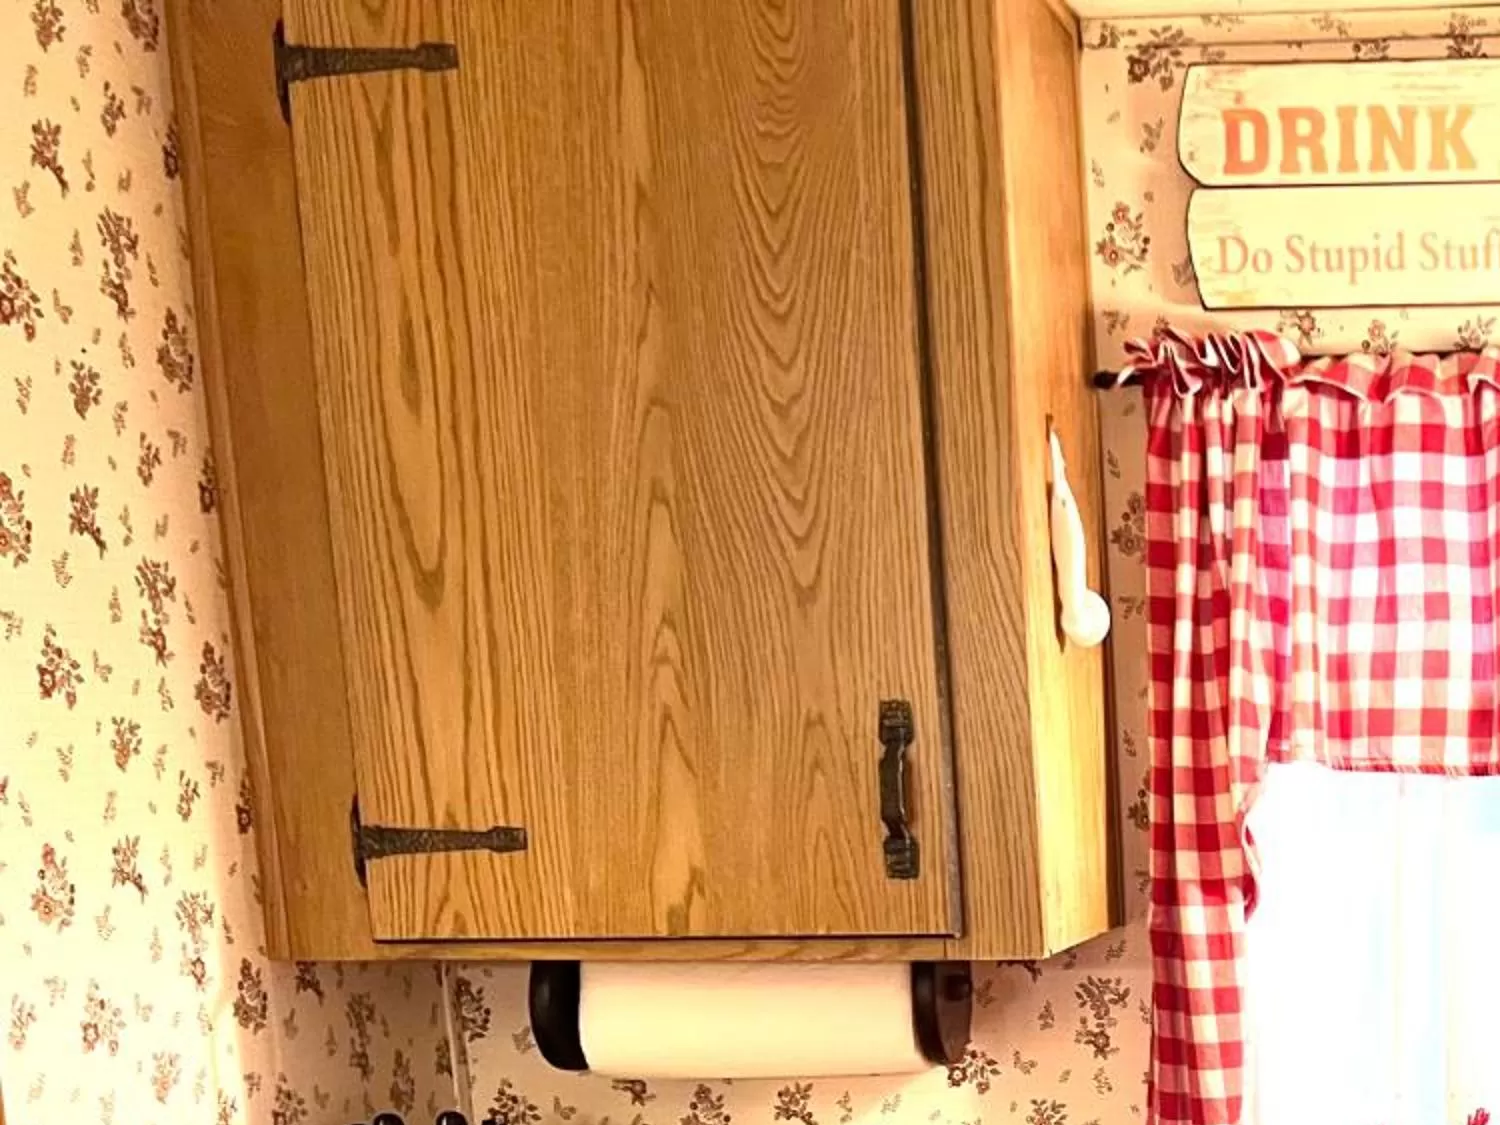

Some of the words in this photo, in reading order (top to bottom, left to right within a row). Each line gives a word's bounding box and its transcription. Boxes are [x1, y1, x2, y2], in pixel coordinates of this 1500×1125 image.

[1222, 104, 1477, 176] DRINK
[1217, 235, 1273, 274] Do
[1285, 229, 1405, 285] Stupid
